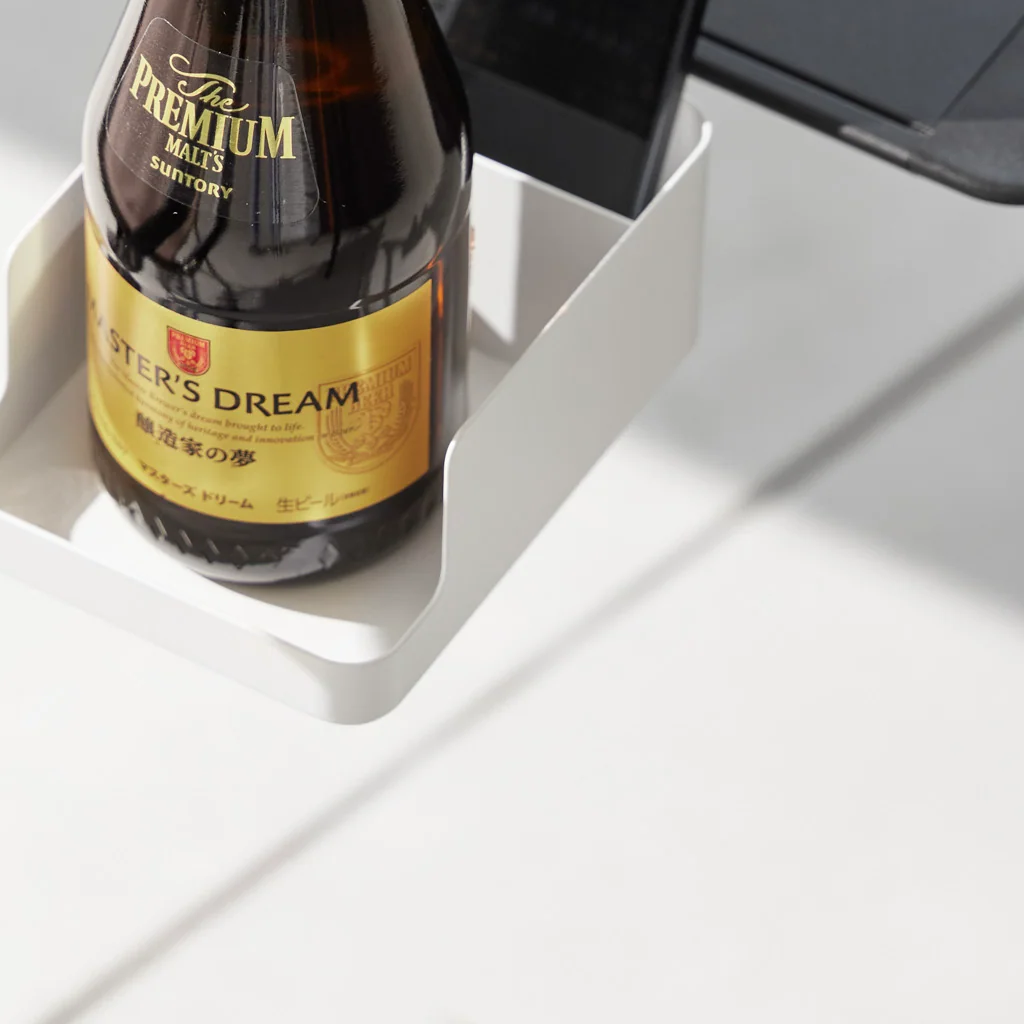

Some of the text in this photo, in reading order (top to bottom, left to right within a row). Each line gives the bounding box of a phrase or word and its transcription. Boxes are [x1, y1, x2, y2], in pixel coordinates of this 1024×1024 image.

[169, 53, 250, 113] The
[129, 53, 297, 160] PREMIUM
[164, 132, 225, 173] MALT'S
[87, 296, 201, 404] STER'S
[214, 381, 359, 417] DREAM
[225, 418, 268, 434] brought
[270, 422, 282, 432] to
[232, 434, 252, 443] and
[255, 434, 315, 445] innovation
[276, 493, 336, 514] 生ビール
